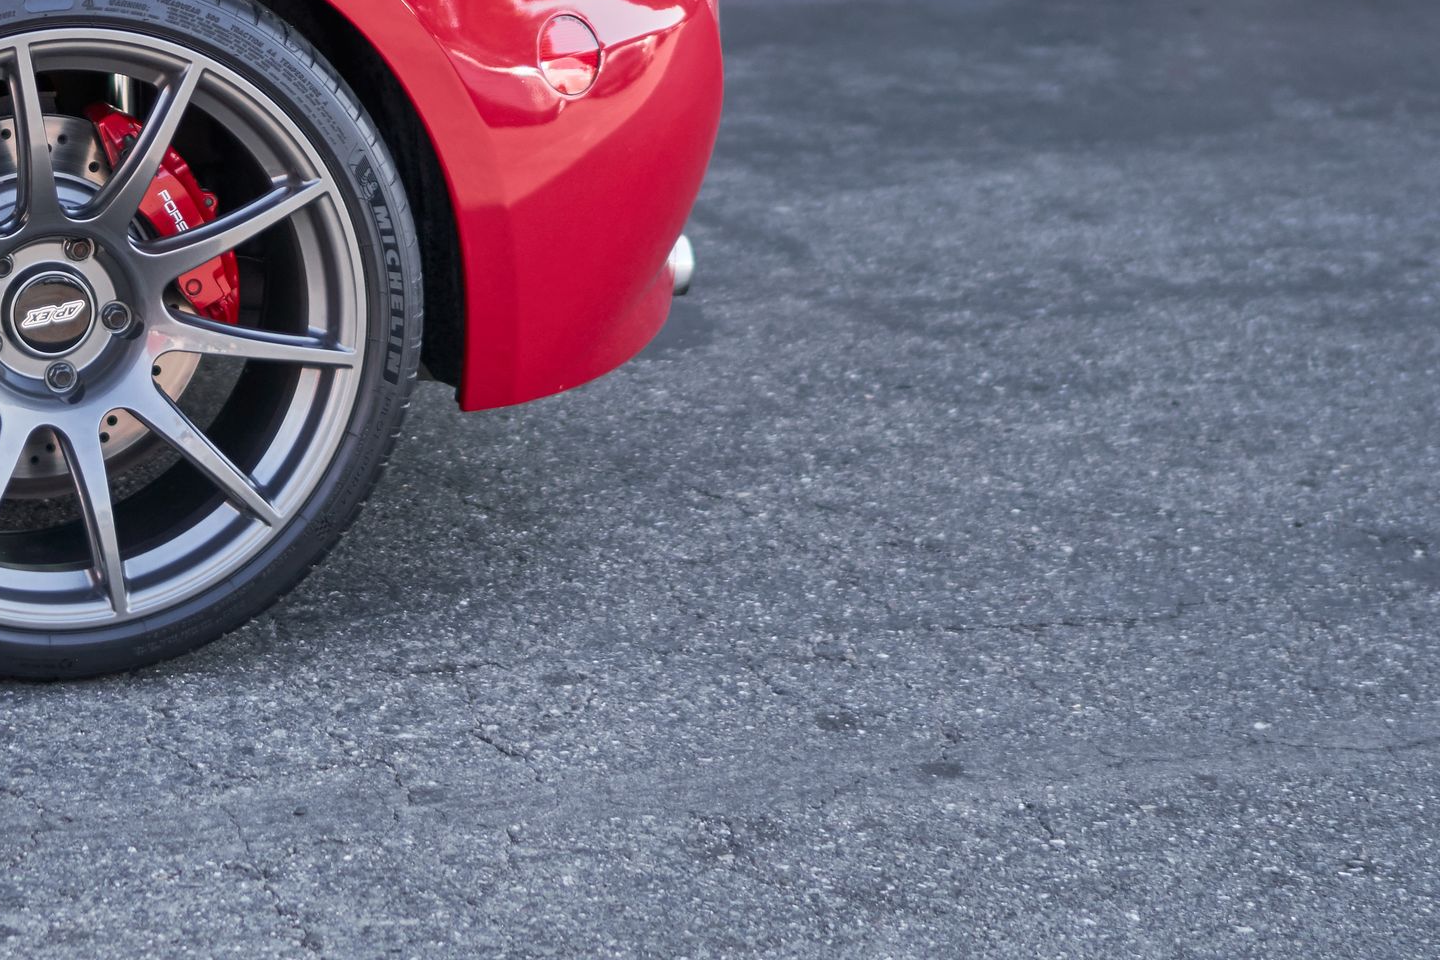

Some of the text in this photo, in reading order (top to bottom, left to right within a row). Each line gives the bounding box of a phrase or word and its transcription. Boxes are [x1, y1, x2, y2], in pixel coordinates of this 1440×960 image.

[230, 24, 264, 47] TRACTION
[280, 58, 322, 98] TEMPERATURE
[22, 300, 85, 328] APEX
[374, 205, 404, 376] MICHELIN
